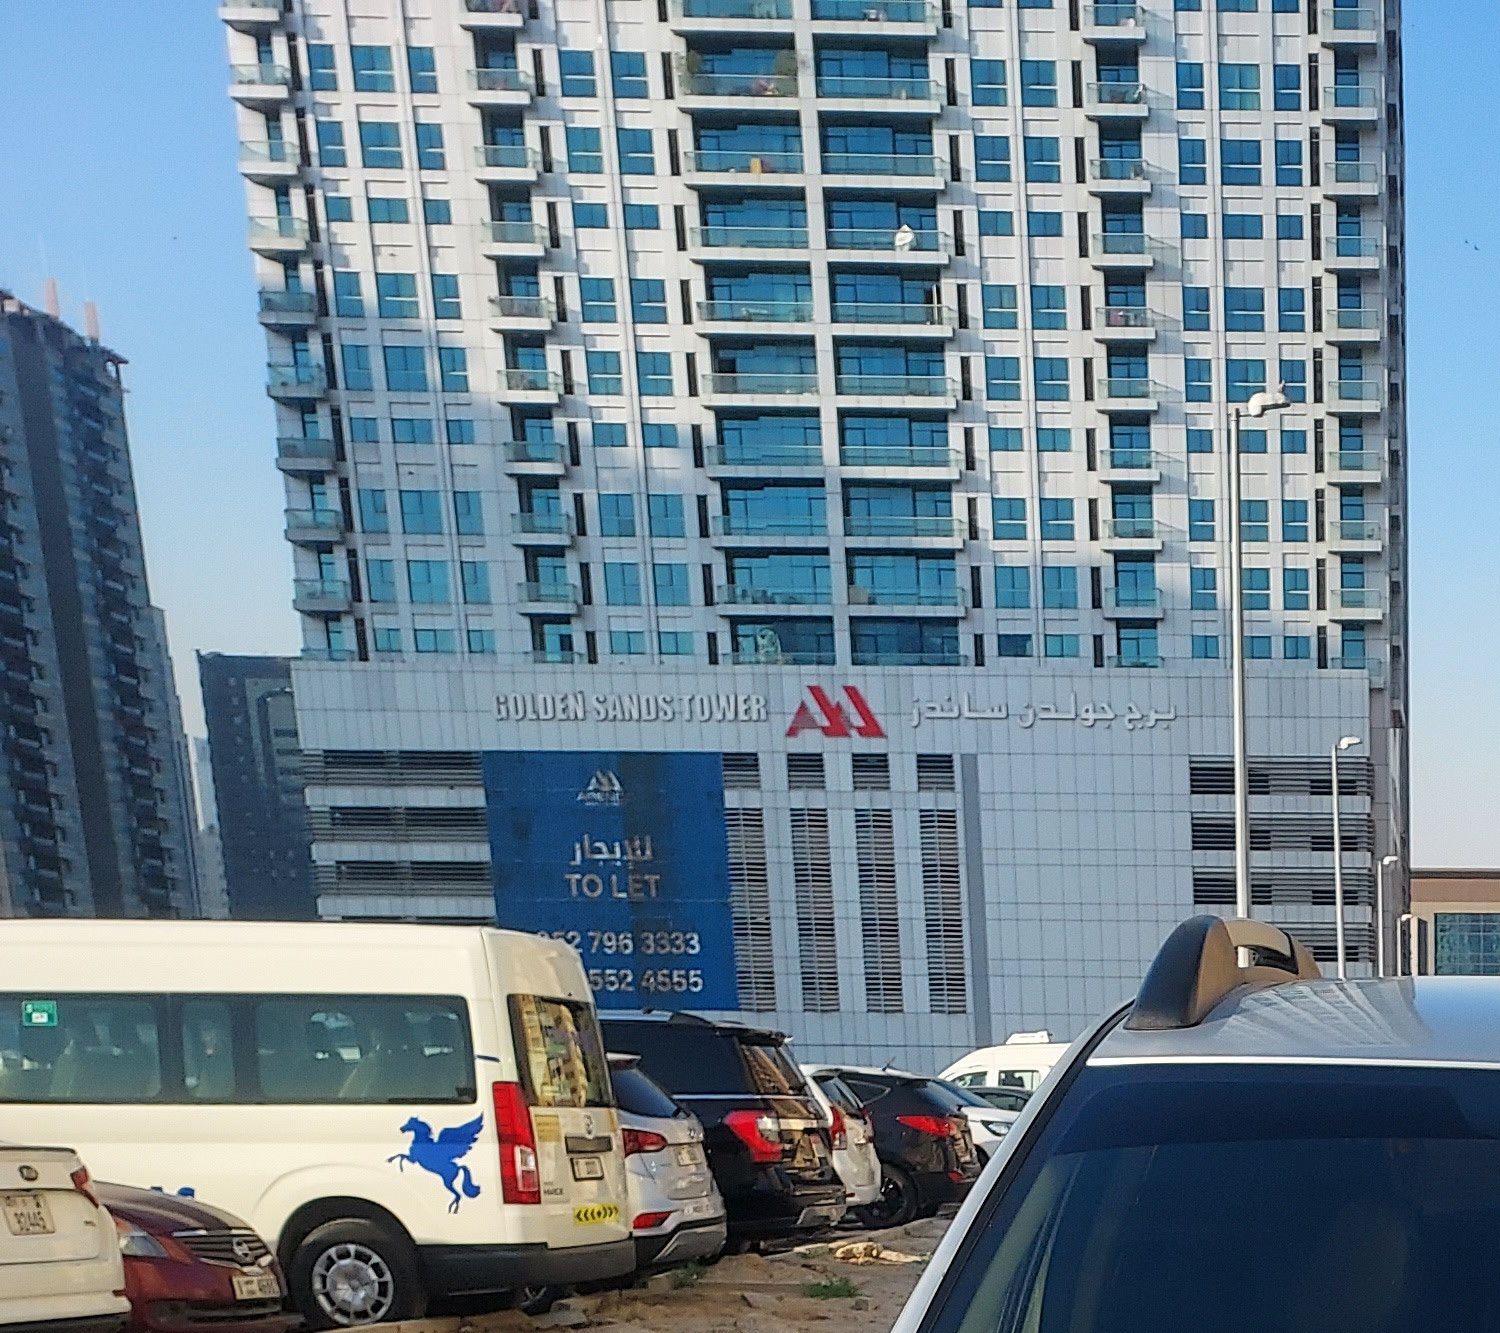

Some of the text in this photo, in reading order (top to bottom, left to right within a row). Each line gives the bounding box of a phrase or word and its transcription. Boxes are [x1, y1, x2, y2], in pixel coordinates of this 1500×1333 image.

[496, 690, 768, 722] GOLDEN SANDS TOWER
[911, 691, 1177, 730] برج جولدن ساندز
[564, 873, 661, 898] TO LET
[587, 931, 634, 954] 796
[640, 931, 700, 955] 3333
[588, 968, 703, 992] 552 4555
